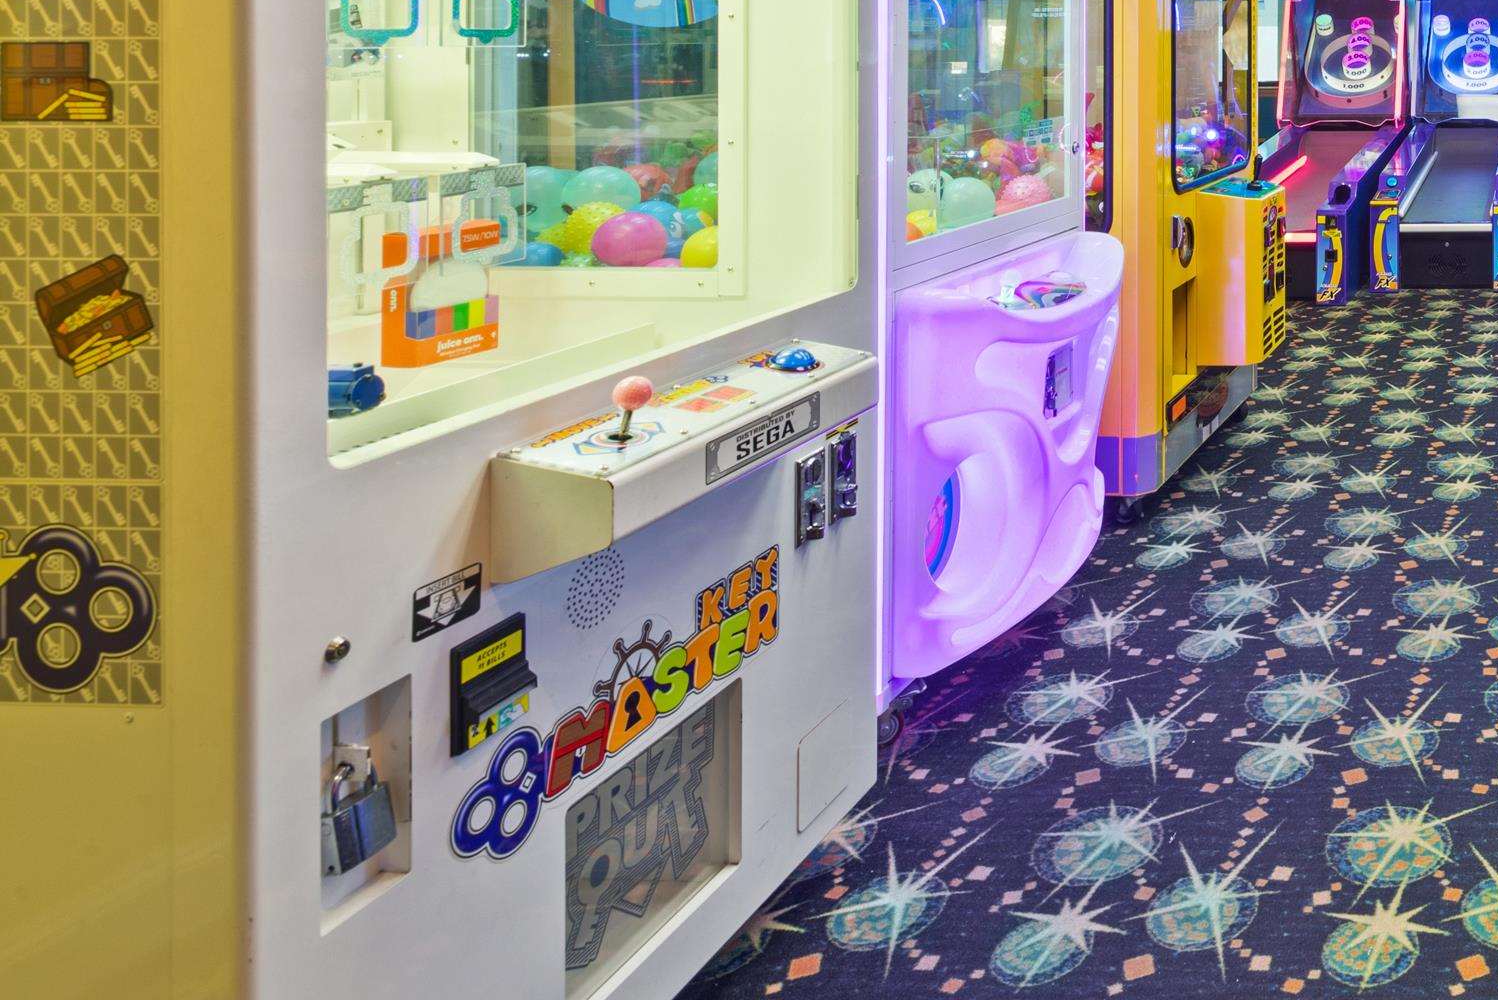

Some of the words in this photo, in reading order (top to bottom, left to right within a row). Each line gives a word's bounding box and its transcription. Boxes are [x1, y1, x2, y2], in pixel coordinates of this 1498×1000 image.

[1320, 288, 1341, 301] FX
[1375, 276, 1396, 289] FX
[436, 339, 462, 353] juice
[463, 334, 484, 345] onn.
[736, 419, 795, 461] SEGA
[737, 416, 784, 443] DISTRIBUTED
[785, 410, 795, 420] BY
[426, 579, 449, 594] INSERT
[451, 573, 465, 585] BILL
[698, 548, 779, 632] KEY
[477, 641, 508, 662] ACCEPTS
[486, 650, 506, 667] BILLS
[546, 588, 779, 798] MASTER
[565, 711, 716, 838] PRIZE
[570, 774, 709, 955] OUT
